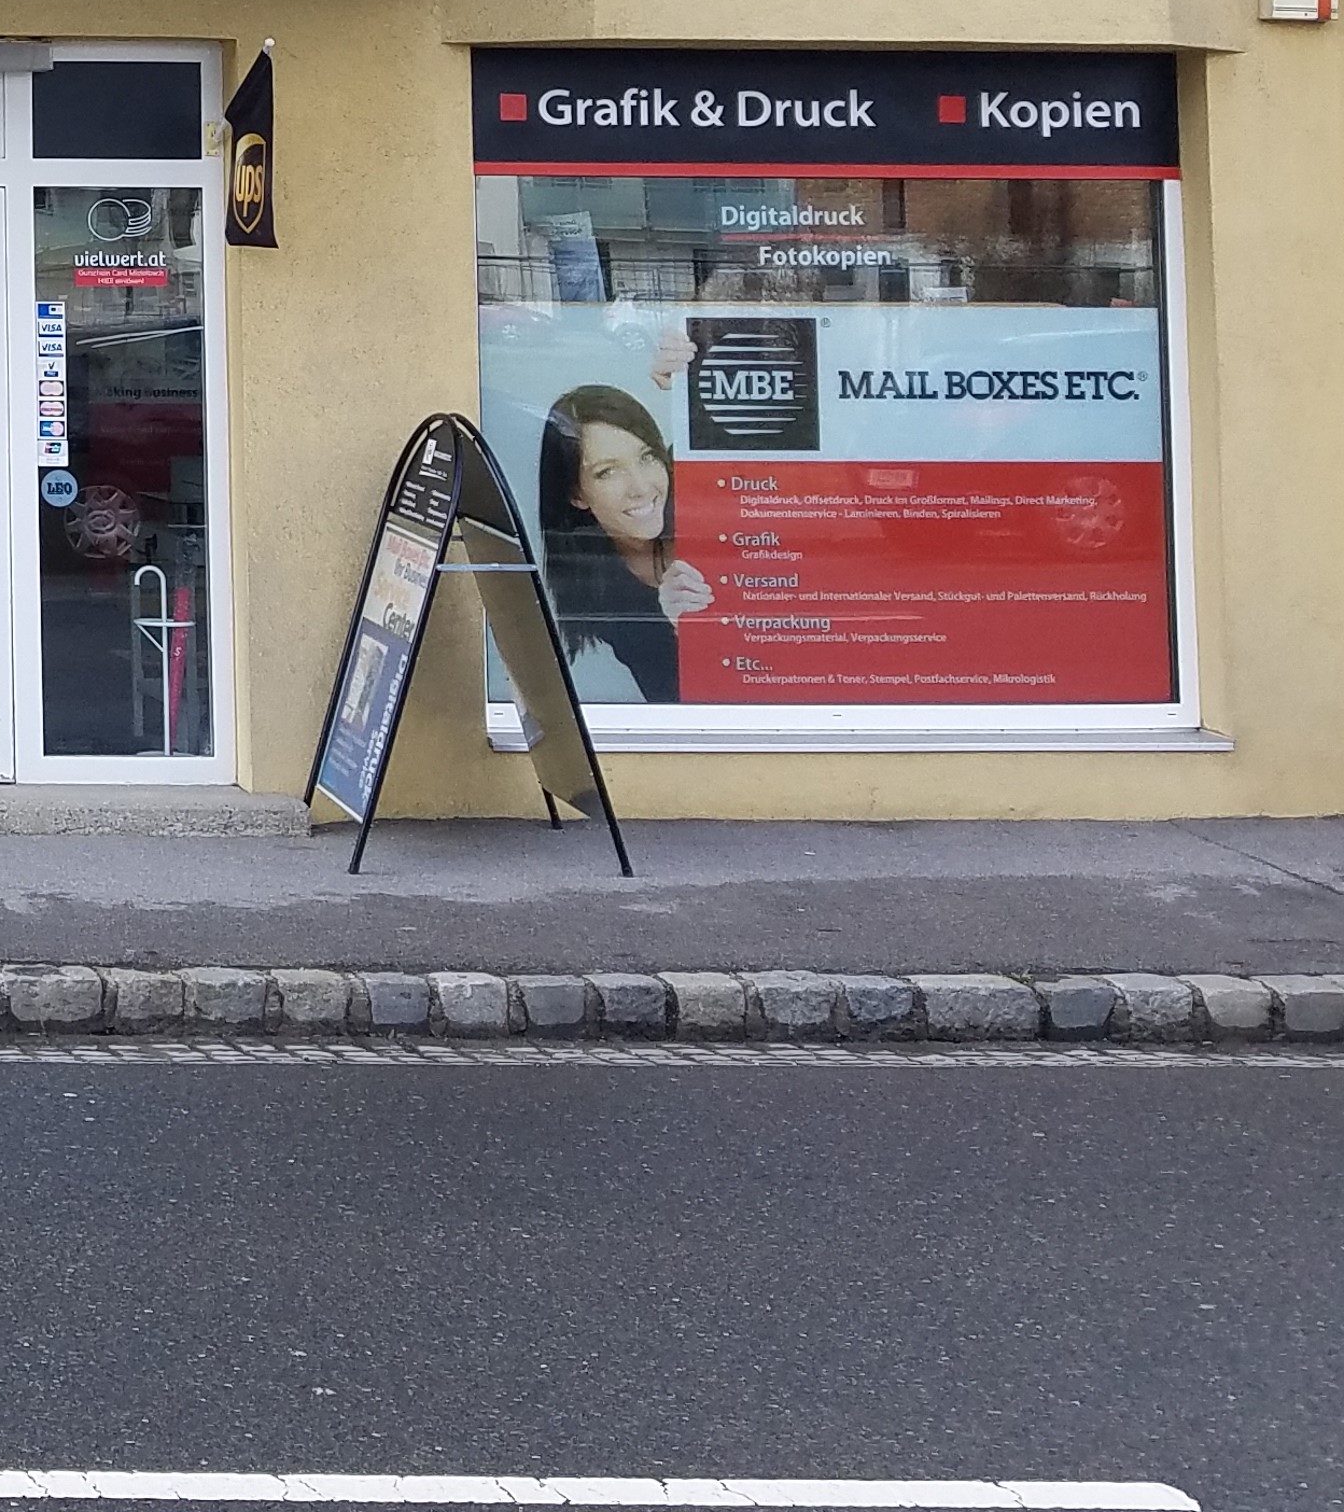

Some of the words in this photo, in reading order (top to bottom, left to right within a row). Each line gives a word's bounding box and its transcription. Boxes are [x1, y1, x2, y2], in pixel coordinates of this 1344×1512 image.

[538, 88, 681, 128] Grafik
[690, 90, 725, 128] &
[737, 89, 877, 129] Druck
[980, 91, 1141, 138] Kopien
[235, 165, 263, 218] ups
[720, 204, 865, 232] Digitaldruck
[74, 250, 166, 267] vielwert.at
[759, 245, 892, 271] Fotokopien
[41, 324, 62, 333] VISA
[41, 343, 63, 352] VISA
[714, 370, 795, 401] MBE
[838, 370, 939, 400] MAIL
[944, 370, 1059, 400] BOXES
[1065, 371, 1140, 401] ETC.
[731, 476, 779, 491] Druck
[864, 495, 892, 505] Druck
[1015, 495, 1045, 505] Direct
[732, 532, 780, 546] Grafik
[742, 550, 803, 561] Grafikdesign
[733, 573, 799, 588] Versand
[798, 591, 818, 601] und
[986, 591, 1006, 601] und
[1089, 591, 1147, 603] Rückholung
[734, 615, 831, 632] Verpackung
[851, 633, 947, 645] Verpackungsservice
[736, 656, 773, 671] Etc...
[742, 674, 826, 686] Druckerpatronen
